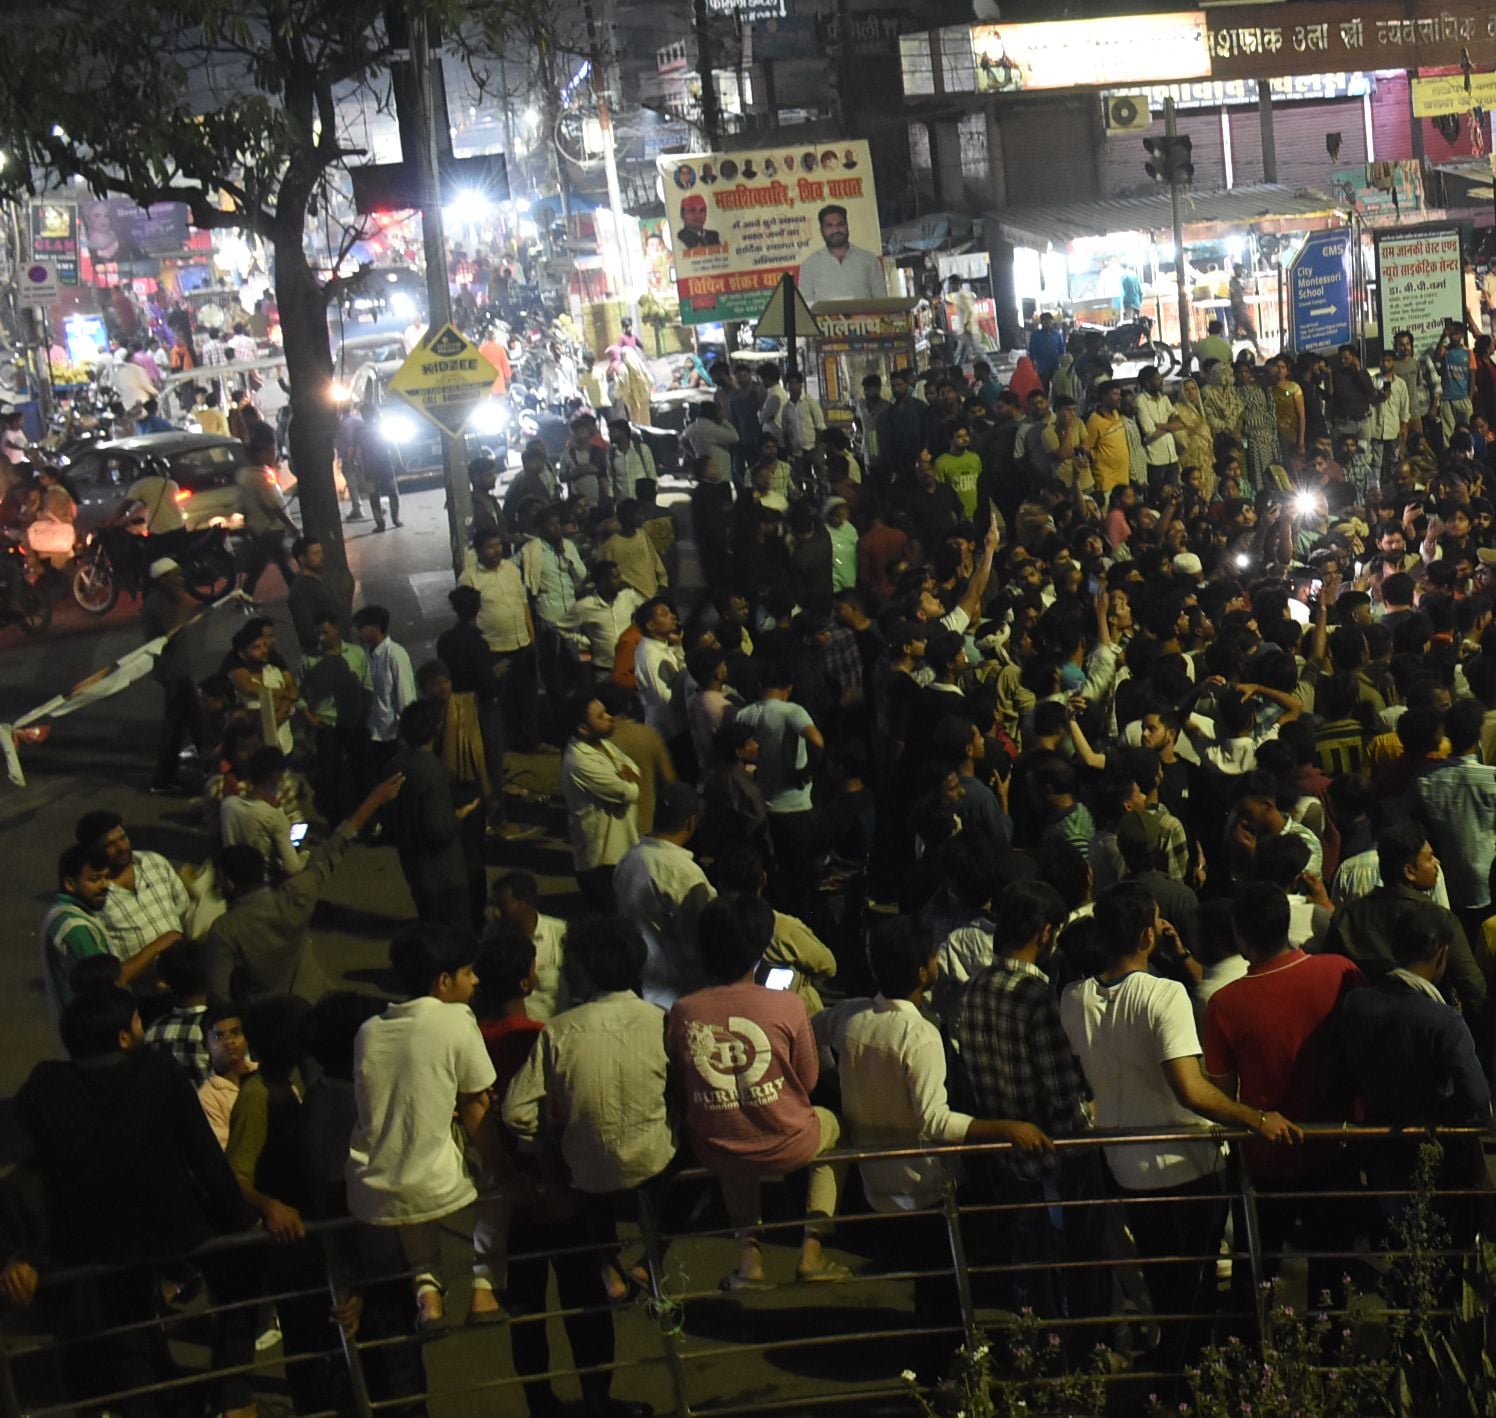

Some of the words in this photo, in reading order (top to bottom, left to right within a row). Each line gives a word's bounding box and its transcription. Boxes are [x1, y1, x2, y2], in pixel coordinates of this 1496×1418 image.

[1322, 244, 1344, 257] CMS
[1381, 245, 1395, 259] राम
[1396, 240, 1424, 257] जानकी
[1441, 240, 1458, 252] एण्ड
[1297, 267, 1313, 277] City
[1298, 272, 1341, 288] Montessori
[1298, 286, 1324, 300] School
[422, 359, 478, 375] KIDZEE
[744, 1093, 779, 1109] ngland
